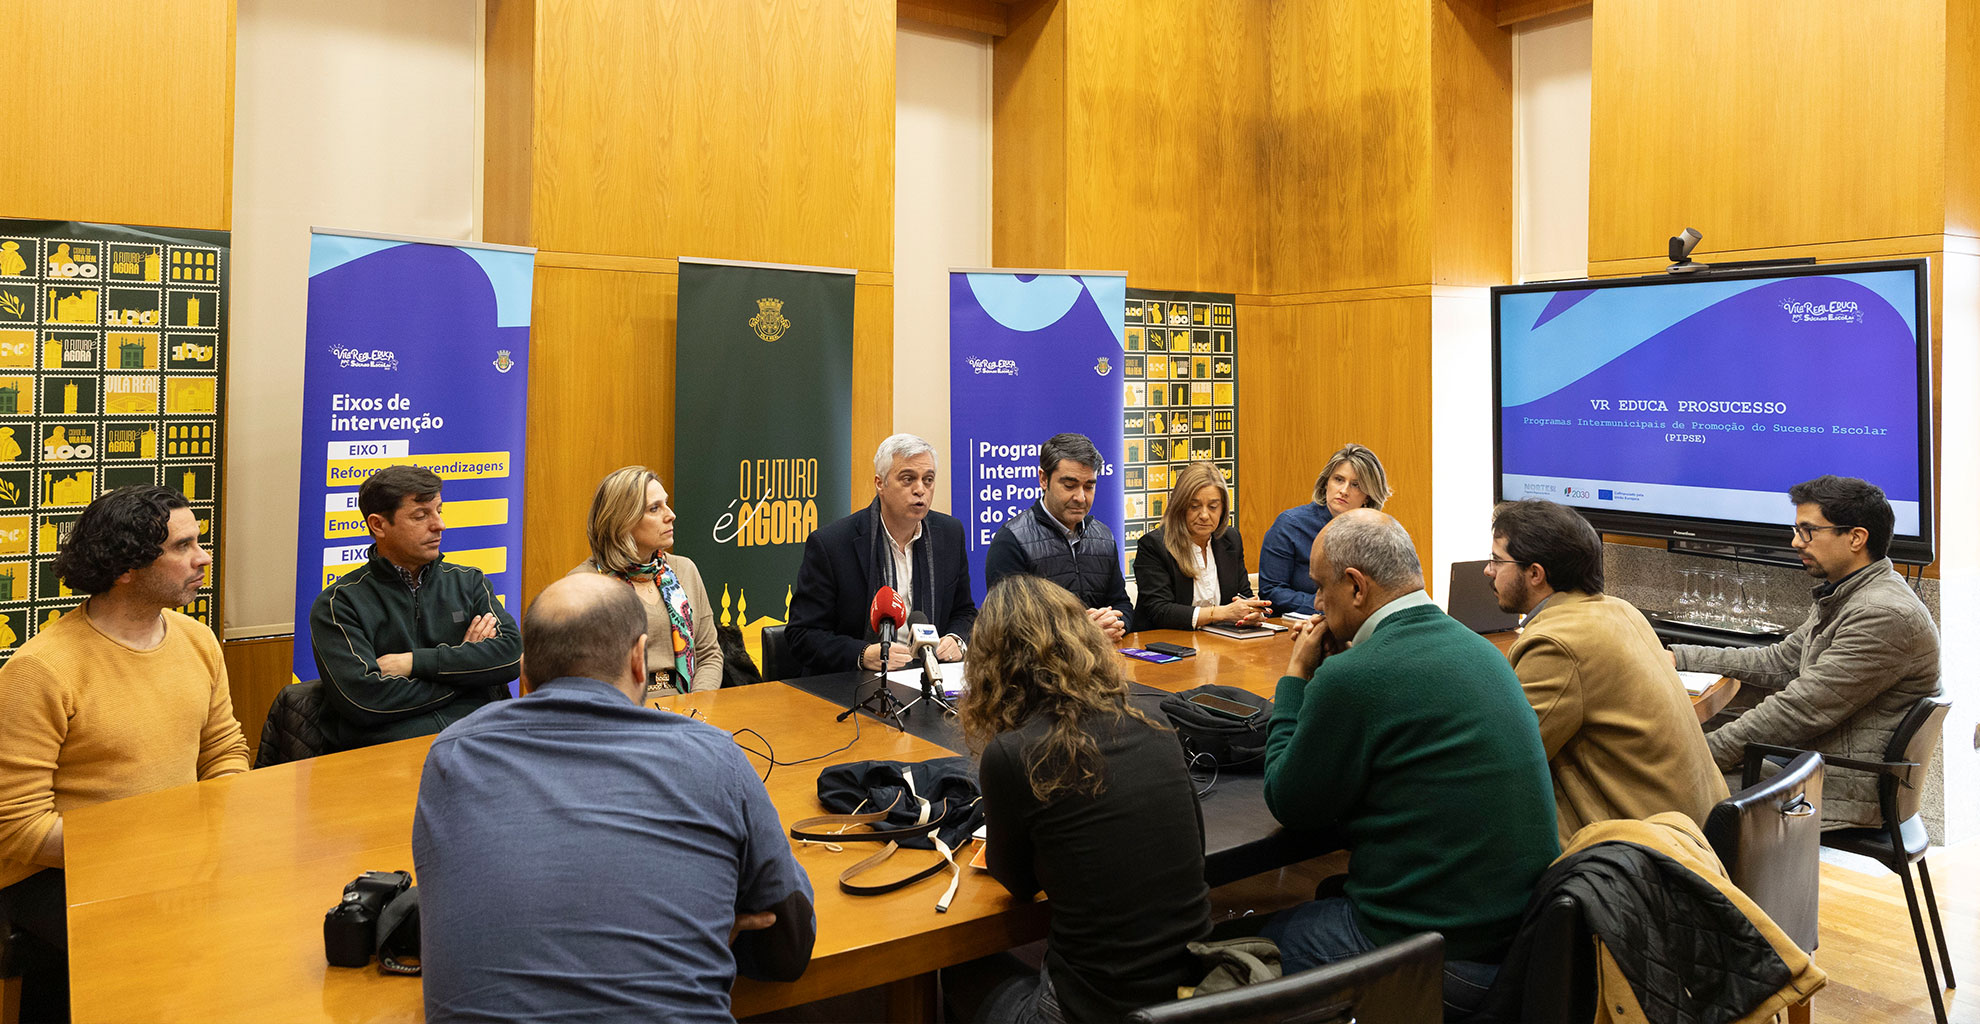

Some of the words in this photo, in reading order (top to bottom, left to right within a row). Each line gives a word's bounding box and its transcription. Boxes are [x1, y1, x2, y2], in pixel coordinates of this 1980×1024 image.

[49, 262, 98, 278] 100
[112, 263, 139, 274] AGORA
[1169, 315, 1188, 325] 100
[64, 350, 91, 362] AGORA
[107, 376, 130, 393] VILA
[132, 376, 158, 393] REAL
[332, 394, 383, 411] Eixos
[387, 393, 410, 410] de
[1590, 400, 1610, 410] VR
[1619, 400, 1668, 411] EDUCA
[1678, 401, 1787, 414] PROSUCESSO
[331, 413, 443, 433] intervenção
[1171, 424, 1188, 432] 100
[1524, 417, 1572, 427] Programas
[1578, 418, 1666, 429] Intermunicipais
[1672, 420, 1685, 429] de
[1691, 422, 1745, 432] Promoção
[1751, 423, 1766, 432] do
[1773, 424, 1825, 433] Sucesso
[1832, 425, 1887, 436] Escolar
[1665, 433, 1706, 443] (PIPSE)
[44, 445, 93, 459] 100
[108, 441, 135, 453] AGORA
[349, 445, 378, 455] EIXO
[382, 445, 387, 454] 1
[740, 459, 751, 500] O
[756, 458, 818, 500] FUTURO
[980, 484, 1002, 501] de
[1572, 490, 1589, 499] 2030
[713, 488, 771, 543] é
[980, 506, 1003, 523] do
[737, 499, 818, 547] AGORA
